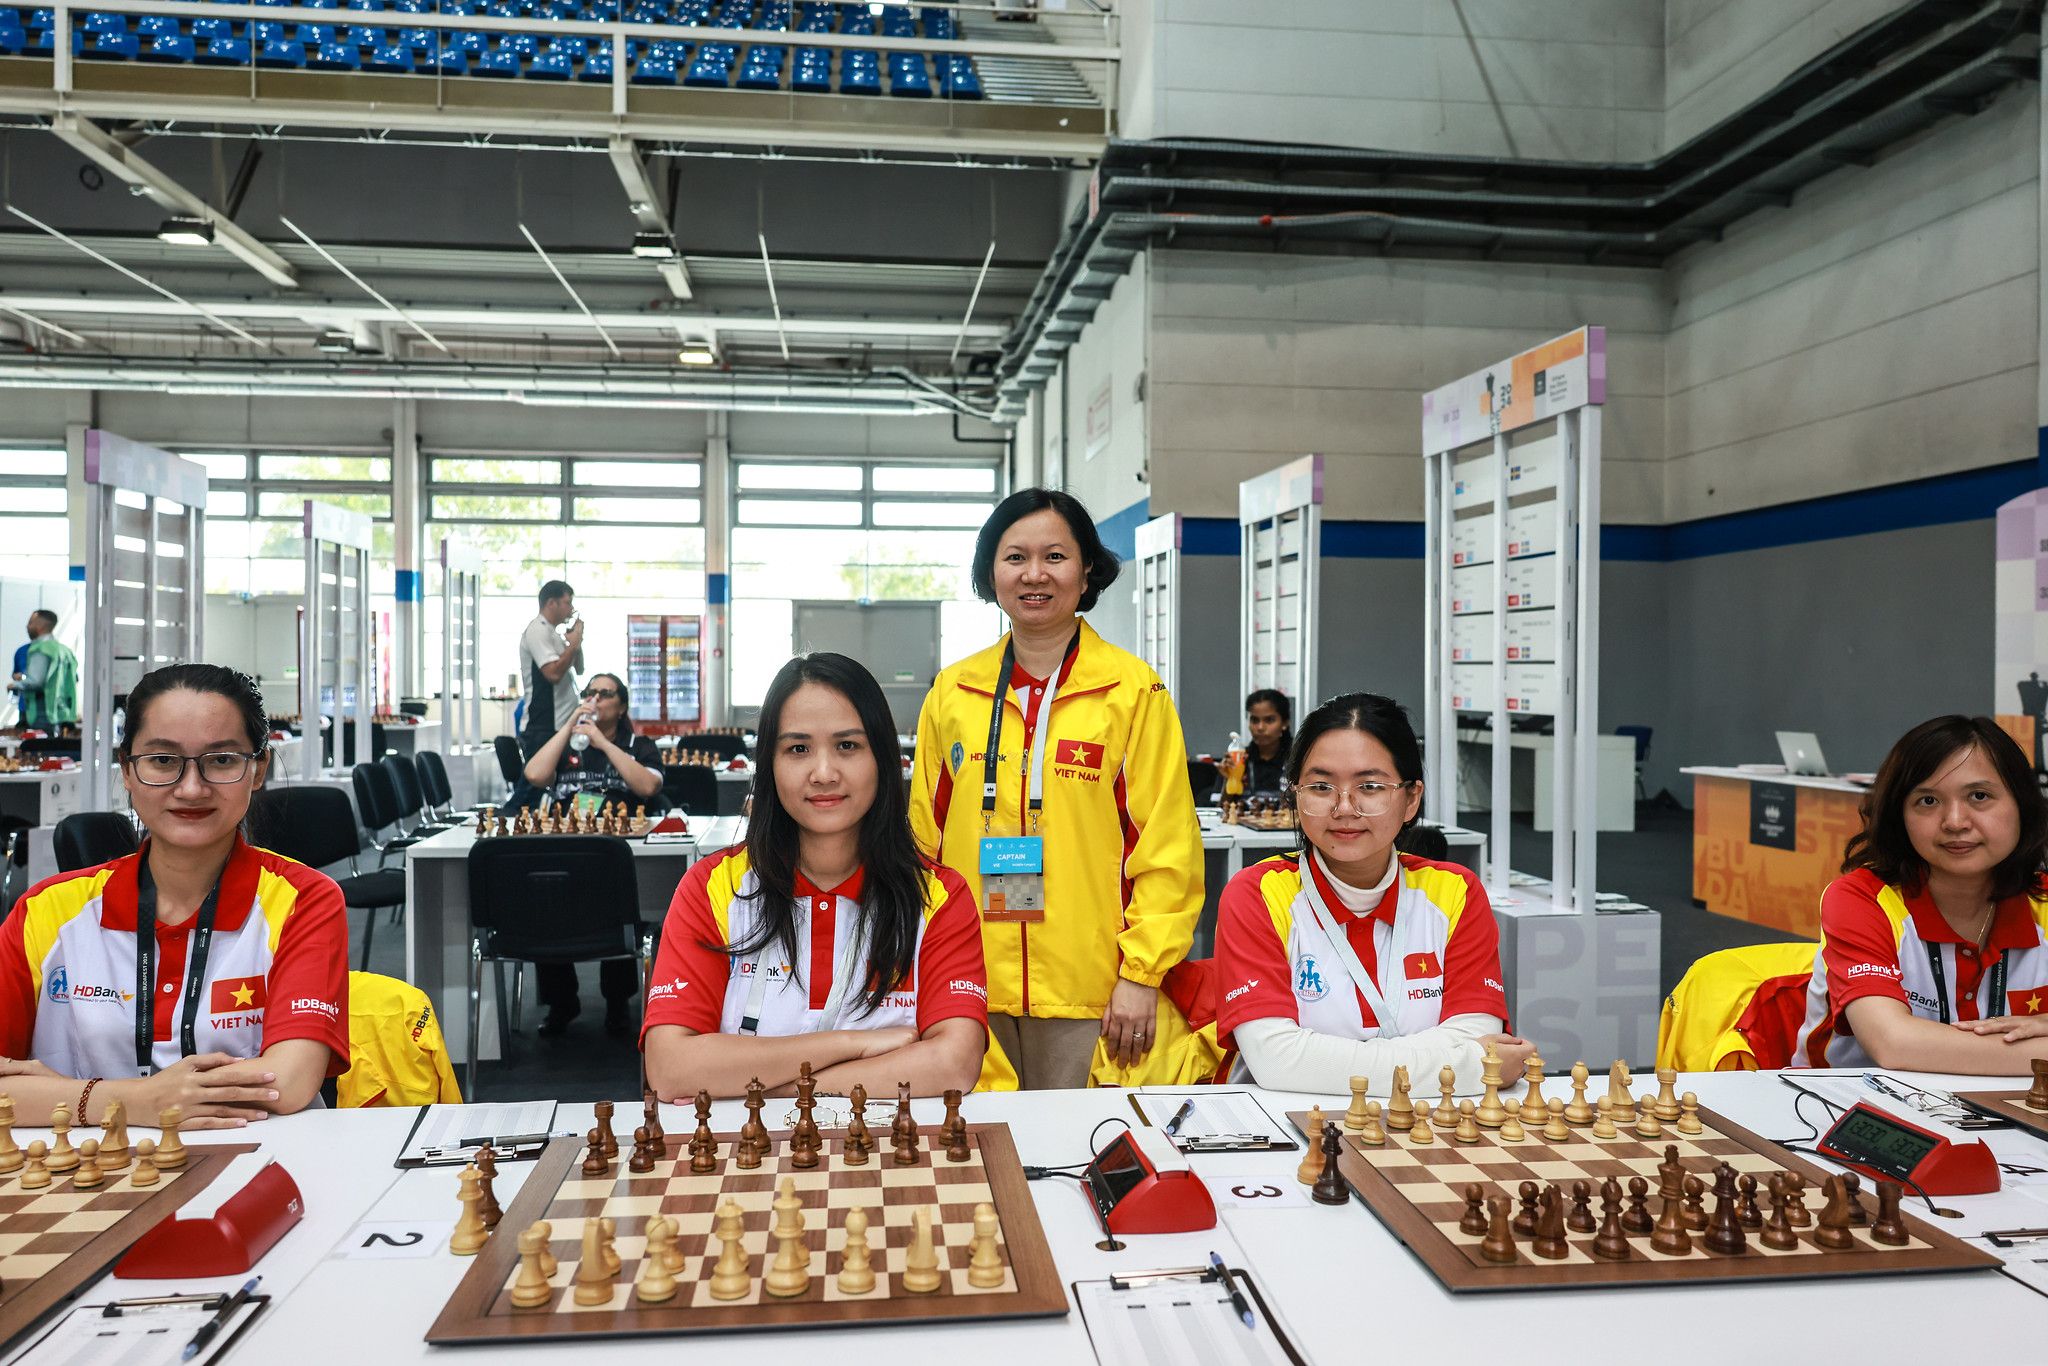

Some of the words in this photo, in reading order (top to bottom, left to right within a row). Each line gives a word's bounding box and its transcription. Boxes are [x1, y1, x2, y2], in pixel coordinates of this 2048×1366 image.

[970, 752, 1007, 762] HDBnk
[1054, 768, 1076, 778] VIET
[1078, 772, 1101, 783] NAM
[996, 853, 1026, 861] CAPTAIN
[740, 962, 780, 977] DBnk
[1847, 963, 1893, 976] HDBank
[1483, 977, 1505, 993] HDBan
[1904, 989, 1939, 1009] DBank
[291, 998, 335, 1016] HDBank
[211, 1017, 242, 1030] VIET
[245, 1014, 263, 1027] NA
[1231, 1185, 1283, 1198] 3
[361, 1232, 424, 1247] 2
